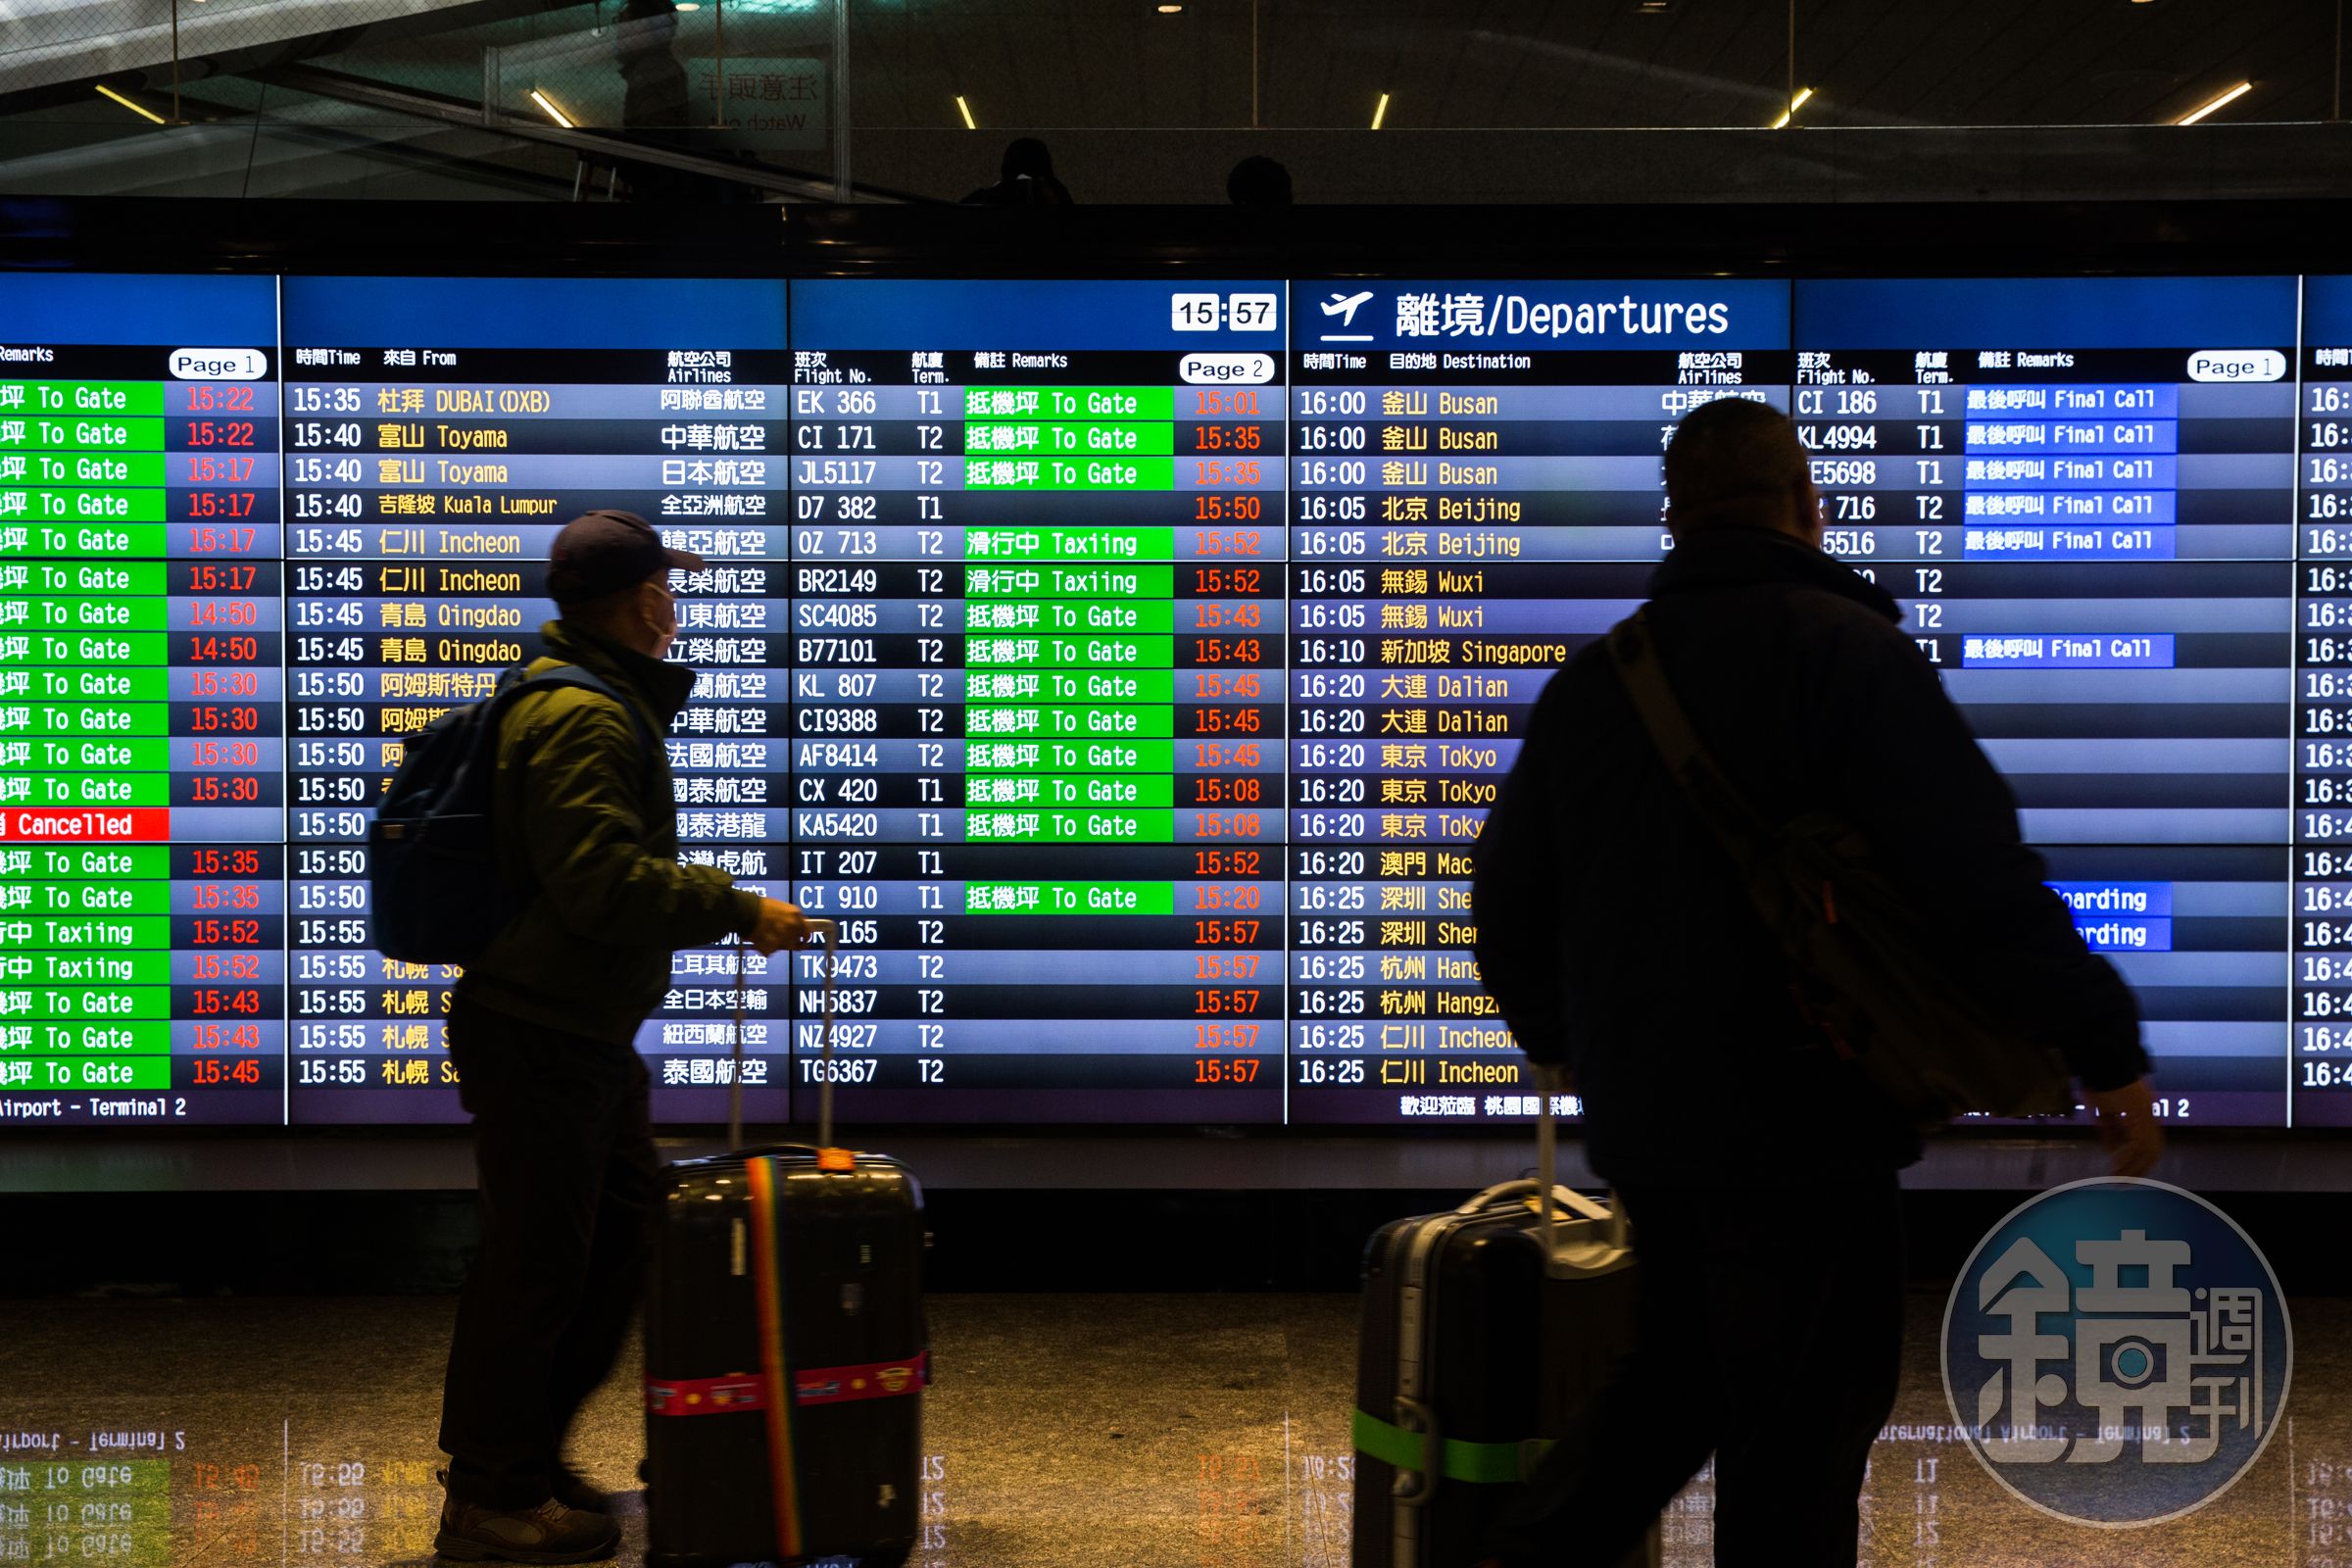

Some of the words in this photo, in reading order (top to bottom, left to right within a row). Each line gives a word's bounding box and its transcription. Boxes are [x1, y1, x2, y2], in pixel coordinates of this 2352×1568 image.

[1176, 298, 1274, 327] 15:57
[1396, 292, 1729, 338] 離境/Departures
[177, 357, 236, 376] Page
[245, 355, 255, 373] 1
[295, 348, 362, 366] 時間Time
[383, 348, 416, 367] 來自
[422, 350, 457, 366] From
[666, 350, 731, 368] 航空公司
[794, 351, 827, 368] 班次
[973, 351, 1006, 369] 備註
[1011, 352, 1068, 368] Remarks
[1303, 352, 1367, 370] 時間Time
[1390, 352, 1438, 369] 目的地
[1443, 353, 1531, 369] Destination
[1678, 352, 1742, 369] 航空公司
[1797, 351, 1831, 369] 班次
[1978, 351, 2012, 368] 備註
[2017, 351, 2075, 368] Remarks
[2196, 359, 2255, 378] Page
[2263, 358, 2273, 376] 1
[667, 368, 732, 383] Airlines
[794, 368, 843, 385] Flight
[849, 368, 872, 384] No.
[911, 368, 950, 384] Term.
[1188, 361, 1245, 381] Page
[1252, 359, 1263, 377] 2
[1678, 368, 1742, 385] Airlines
[1797, 368, 1846, 385] Flight
[1852, 368, 1876, 384] No.
[1915, 368, 1954, 384] Term.
[37, 385, 64, 409] To
[74, 386, 126, 410] Gate
[187, 385, 255, 412] 15:22
[294, 387, 362, 412] 15:35
[377, 387, 425, 414] 杜拜
[436, 389, 551, 414] DUBAI(DXB)
[660, 388, 766, 411] 阿聯酋航空
[798, 390, 825, 415] EK
[837, 390, 877, 415] 366
[916, 390, 943, 415] T1
[965, 390, 1040, 416] 抵機坪
[1051, 391, 1077, 415] To
[1087, 391, 1138, 415] Gate
[1195, 390, 1261, 416] 15:01
[1300, 390, 1366, 415] 16:00
[1382, 390, 1428, 416] 釜山
[1439, 391, 1498, 415] Busan
[1797, 390, 1824, 415] CI
[1837, 390, 1878, 415] 186
[1917, 389, 1944, 415] T1
[1967, 389, 2046, 410] 最後呼叫
[2054, 389, 2105, 409] Final
[2114, 389, 2154, 409] Call
[294, 422, 362, 447] 15:40
[377, 422, 424, 448] 富山
[436, 424, 508, 450] Toyama
[661, 423, 766, 451] 中華航空
[798, 425, 823, 449] CI
[837, 425, 876, 450] 171
[916, 425, 943, 450] T2
[1196, 425, 1261, 450] 15:35
[295, 493, 363, 517] 15:40
[378, 493, 436, 514] 吉隆坡
[444, 495, 492, 514] Kuala
[500, 495, 558, 516] Lumpur
[661, 494, 766, 516] 全亞洲航空
[798, 495, 825, 519] D7
[837, 495, 877, 519] 382
[916, 495, 944, 519] T1
[1195, 496, 1261, 520] 15:50
[1300, 496, 1366, 520] 16:05
[1381, 495, 1428, 521] 北京
[1439, 497, 1521, 522] Beijing
[1965, 495, 2044, 515] 最後呼叫
[2052, 495, 2103, 514] Final
[2112, 495, 2152, 514] Call
[296, 528, 363, 553] 15:45
[378, 528, 425, 555] 仁川
[438, 530, 520, 554] Incheon
[837, 530, 877, 555] 713
[916, 530, 944, 555] T2
[966, 530, 1040, 556] 滑行中
[1052, 532, 1138, 557] Taxiing
[1195, 530, 1261, 556] 15:52
[1299, 568, 1365, 593] 16:05
[1381, 568, 1428, 595] 無錫
[1438, 570, 1483, 593] Wuxi
[1915, 568, 1942, 593] T2
[41, 601, 68, 624] To
[78, 602, 130, 624] Gate
[189, 600, 258, 626] 14:50
[296, 602, 364, 626] 15:45
[379, 602, 427, 628] 青島
[438, 604, 521, 629] Qingdao
[799, 604, 877, 627] SC4085
[1195, 603, 1261, 628] 15:43
[799, 638, 877, 662] B77101
[1299, 639, 1365, 662] 16:10
[1381, 638, 1450, 664] 新加坡
[1461, 640, 1567, 665] Singapore
[1964, 638, 2043, 660] 最後呼叫
[2051, 639, 2101, 658] Final
[2110, 638, 2151, 658] Call
[799, 673, 825, 698] KL
[838, 673, 877, 698] 807
[1299, 673, 1365, 698] 16:20
[1381, 673, 1428, 699] 大連
[1438, 674, 1508, 698] Dalian
[799, 709, 877, 732] CI9388
[1195, 709, 1260, 732] 15:45
[799, 743, 878, 767] AF8414
[1299, 744, 1365, 767] 16:20
[1380, 743, 1428, 768] 東京
[1438, 744, 1496, 769] Tokyo
[18, 812, 133, 836] Cancelled
[298, 811, 366, 836] 15:50
[799, 812, 878, 837] KA5420
[1195, 812, 1261, 837] 15:08
[801, 851, 826, 874] IT
[838, 851, 878, 874] 207
[1380, 851, 1427, 876] 澳門
[1195, 885, 1261, 910] 15:20
[1380, 885, 1426, 911] 深圳
[44, 921, 133, 946] Taxiing
[192, 919, 260, 944] 15:52
[299, 919, 367, 944] 15:55
[1380, 955, 1426, 981] 杭州
[45, 1061, 72, 1084] To
[82, 1061, 134, 1084] Gate
[193, 1059, 260, 1084] 15:45
[299, 1058, 367, 1084] 15:55
[381, 1058, 429, 1085] 札幌
[917, 1058, 944, 1083] T2
[1195, 1058, 1260, 1083] 15:57
[1298, 1059, 1365, 1083] 16:25
[1380, 1058, 1425, 1085] 仁川
[1439, 1060, 1519, 1083] Incheon
[89, 1098, 166, 1116] Terminal
[174, 1097, 186, 1116] 2
